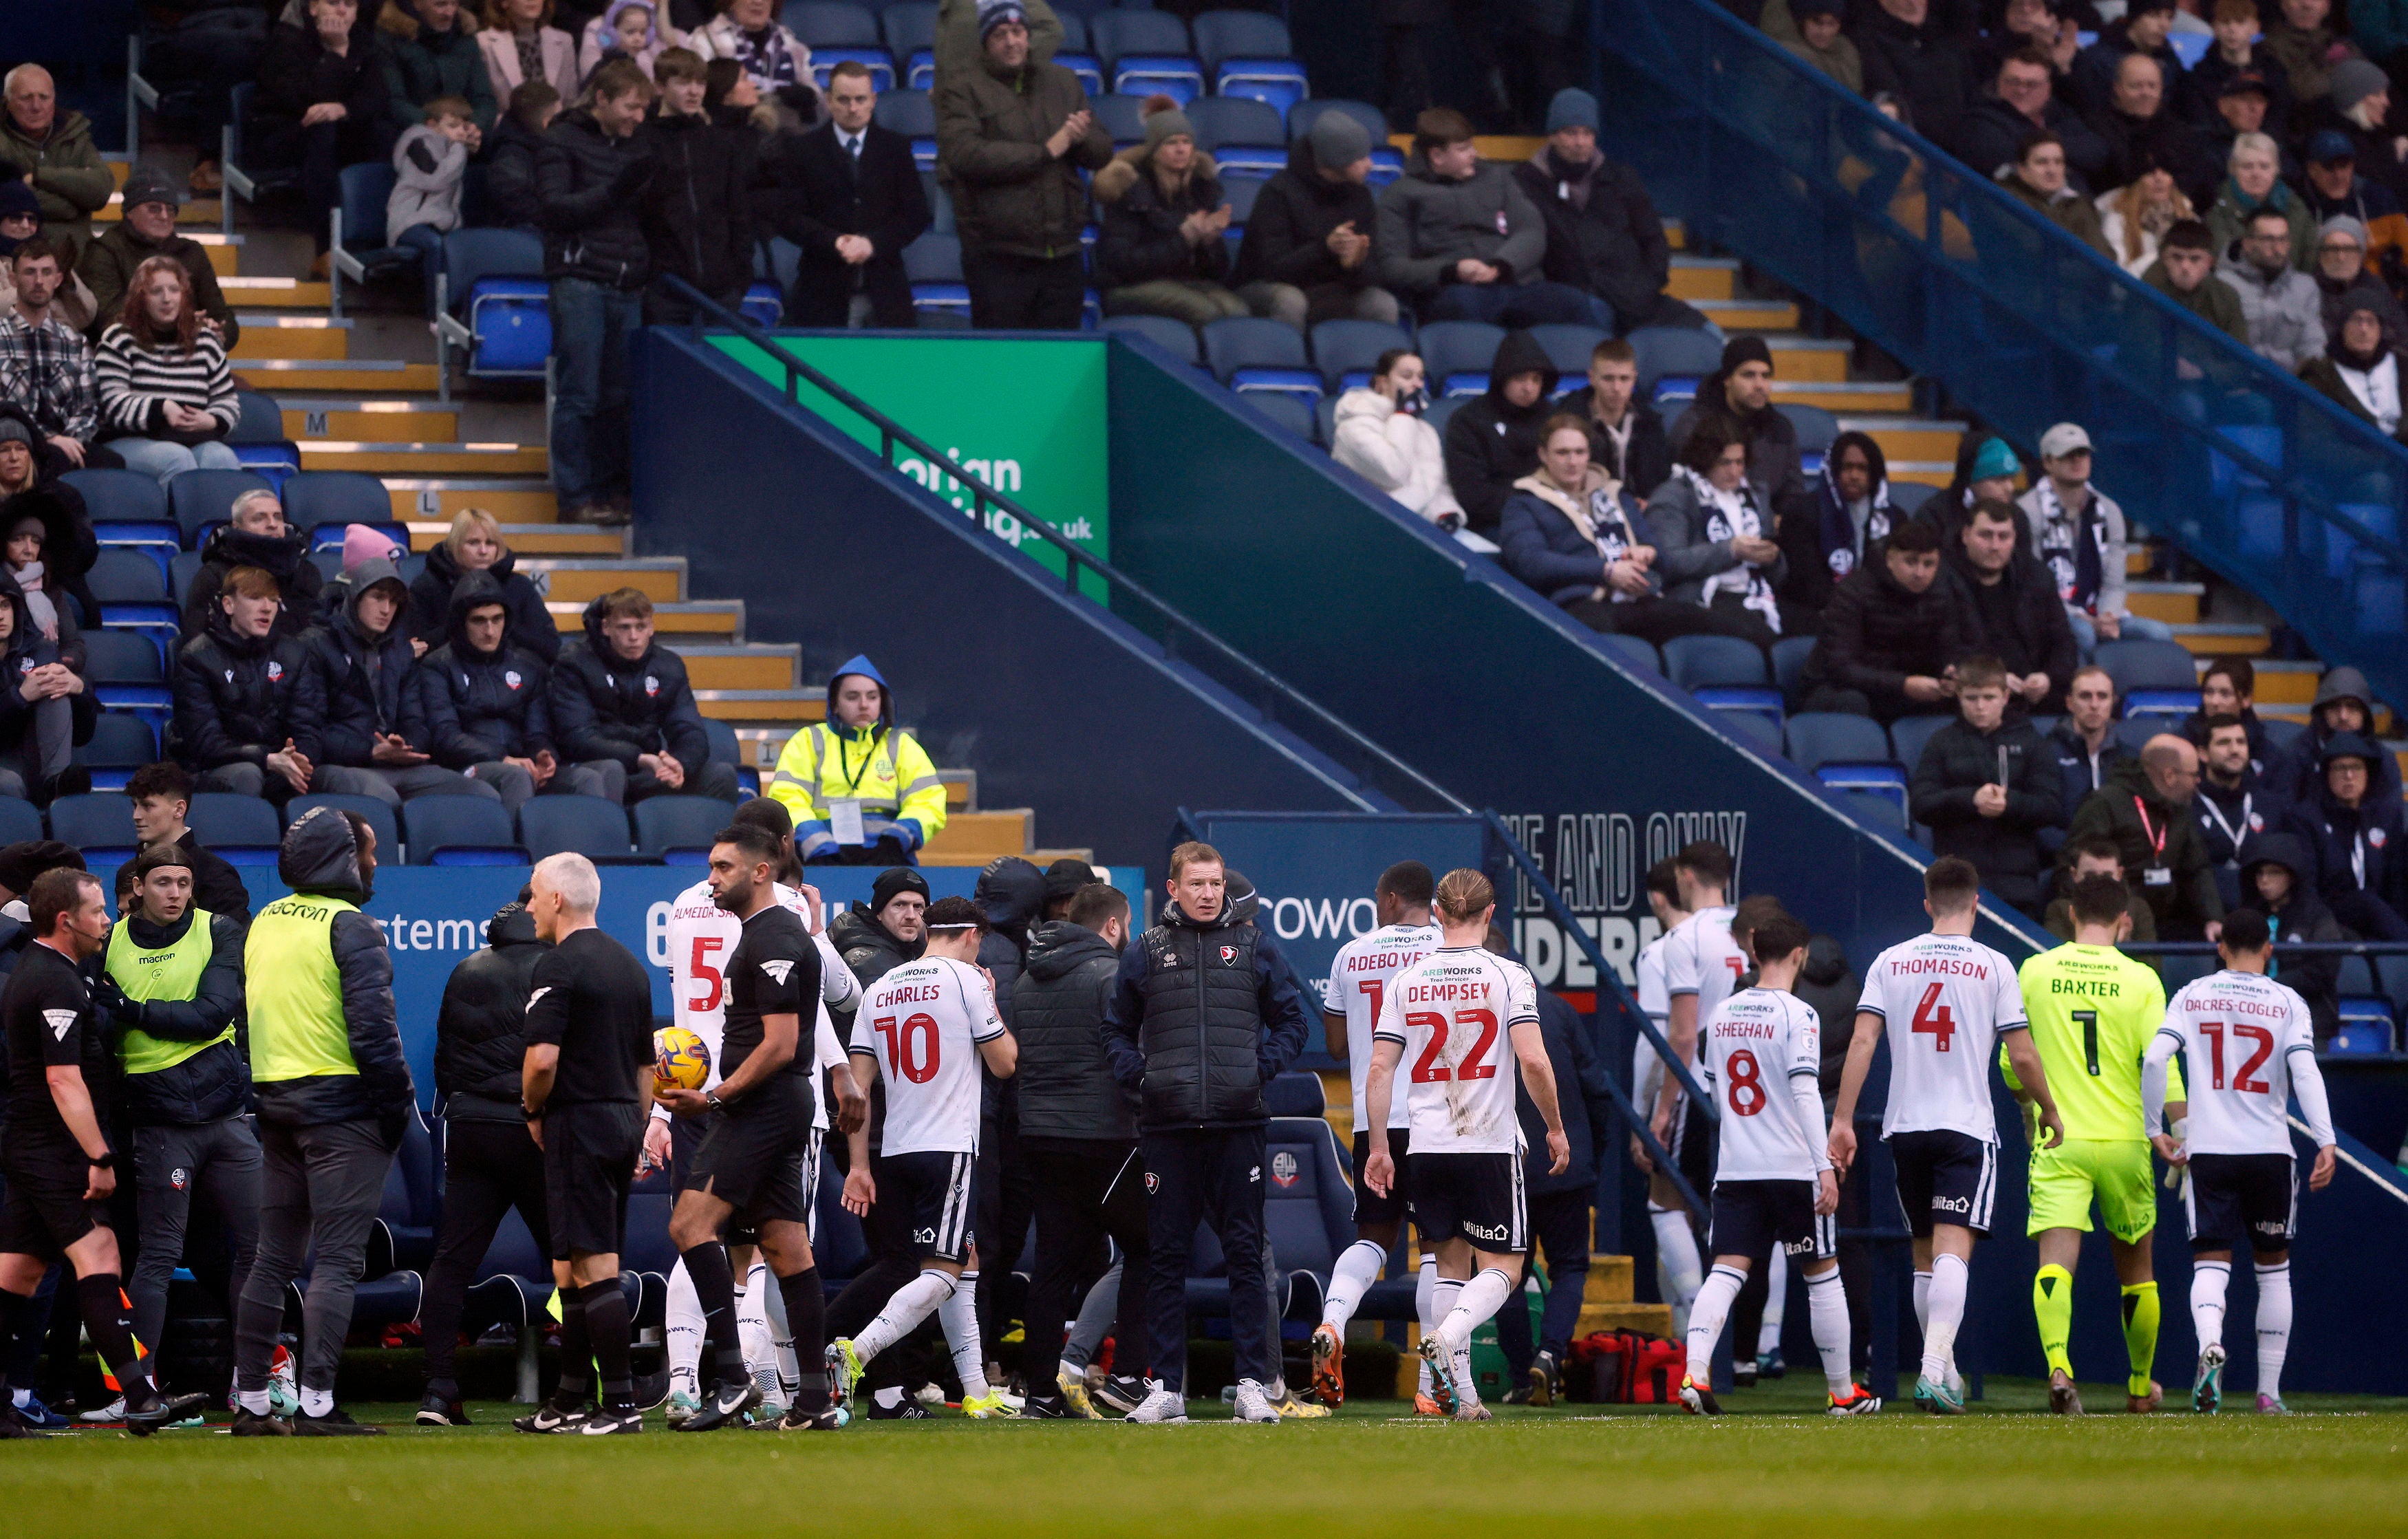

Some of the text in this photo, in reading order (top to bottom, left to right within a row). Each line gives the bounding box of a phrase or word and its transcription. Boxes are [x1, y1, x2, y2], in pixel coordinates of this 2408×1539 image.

[308, 413, 327, 433] M
[423, 493, 435, 513] L
[530, 573, 546, 594] K
[1554, 812, 1635, 912] AND
[1646, 811, 1747, 908] OY
[673, 906, 714, 921] ALMEIDA
[1258, 897, 1378, 939] OWO
[1514, 916, 1664, 987] DER
[1913, 943, 1972, 953] ARBWORKS
[139, 953, 175, 965] macron
[1347, 951, 1431, 972] ADEBOYE
[1891, 959, 1988, 980] THOMASON
[2058, 960, 2118, 971] ARBWORKS
[689, 937, 723, 1012] 5
[889, 967, 938, 982] ARBWORKS
[1422, 967, 1482, 977] ARBWORKS
[876, 984, 940, 1008] CHARLES
[1408, 982, 1492, 1003] DEMPSEY
[2052, 979, 2120, 997] BAXTER
[1728, 1004, 1774, 1013] ARBWORKS
[1911, 982, 1955, 1052] 4
[2185, 999, 2288, 1019] DACRES-COGLEY
[1715, 1021, 1774, 1040] SHEEHAN
[873, 1012, 940, 1084] 10
[1406, 1008, 1498, 1084] 22
[2072, 1010, 2100, 1076] 1
[2200, 1022, 2274, 1094] 12
[1726, 1048, 1766, 1117] 8
[1463, 1220, 1494, 1240] utilita
